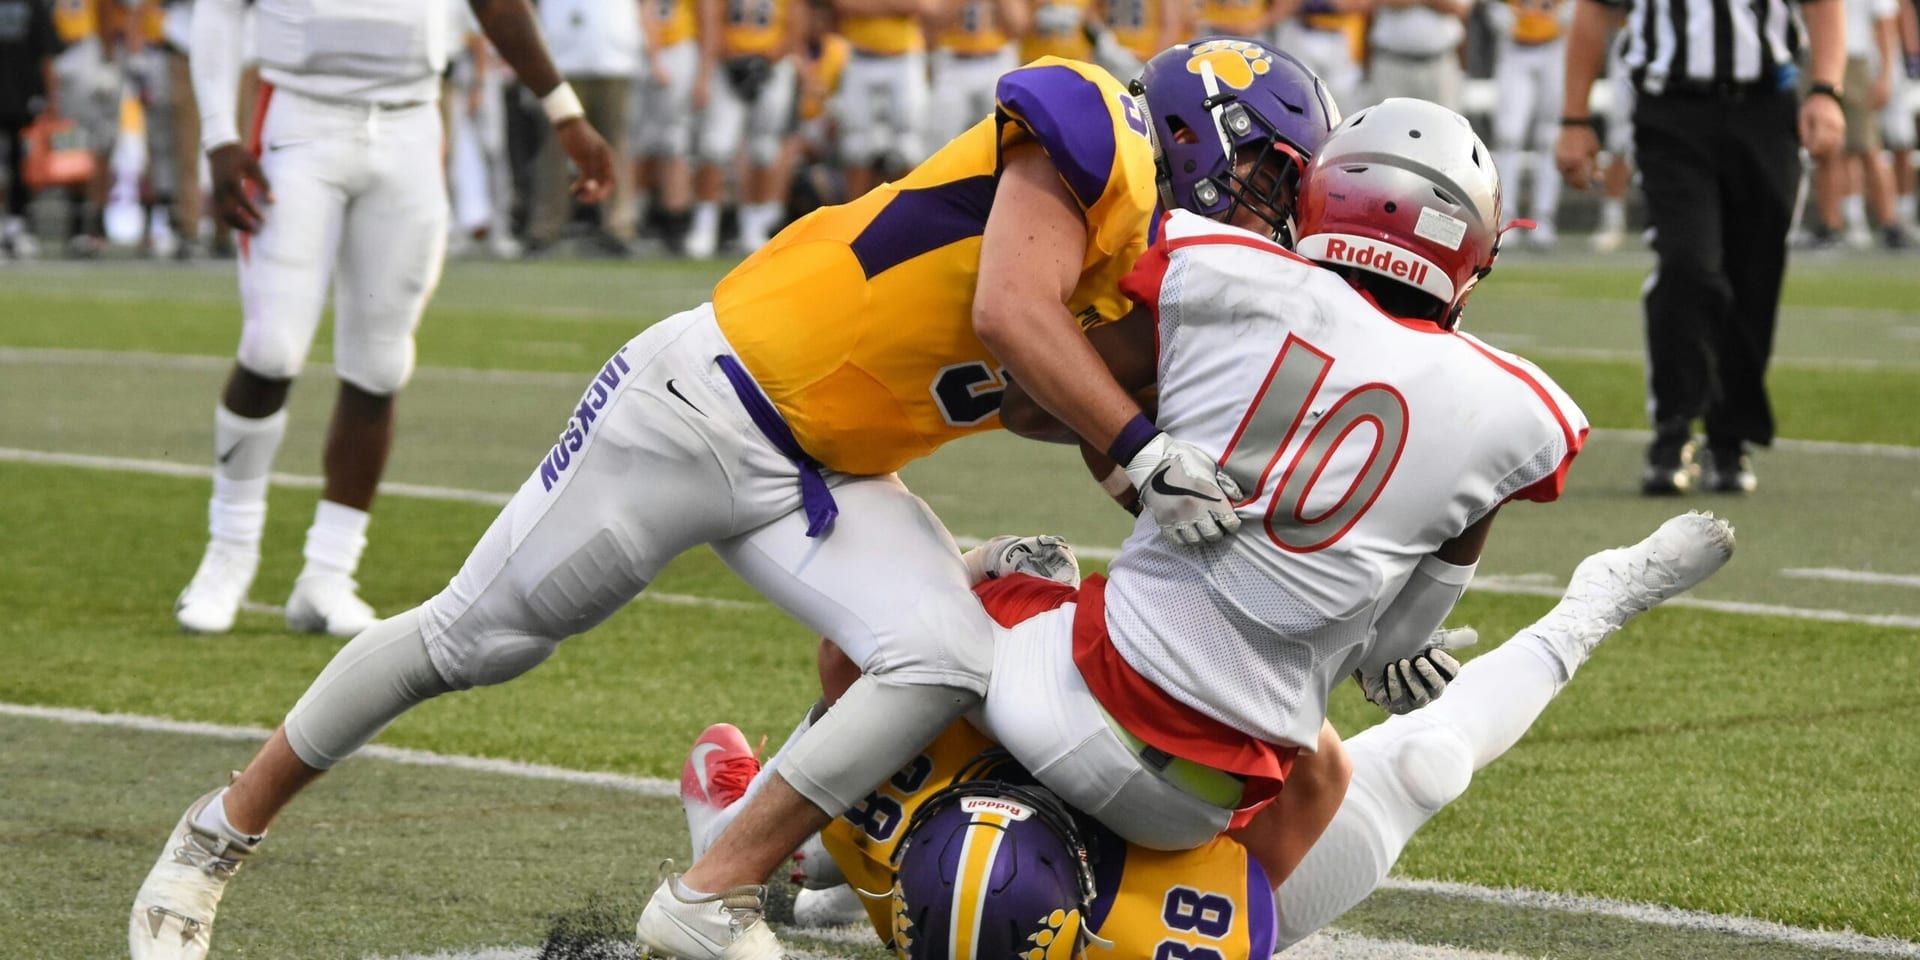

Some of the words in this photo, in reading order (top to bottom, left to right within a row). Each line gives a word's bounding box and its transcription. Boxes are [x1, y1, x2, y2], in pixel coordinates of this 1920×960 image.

[1325, 237, 1429, 286] Riddell
[1075, 304, 1102, 328] PO
[540, 346, 631, 492] JACKSON
[1217, 330, 1410, 553] 10
[967, 800, 1021, 816] Riddell
